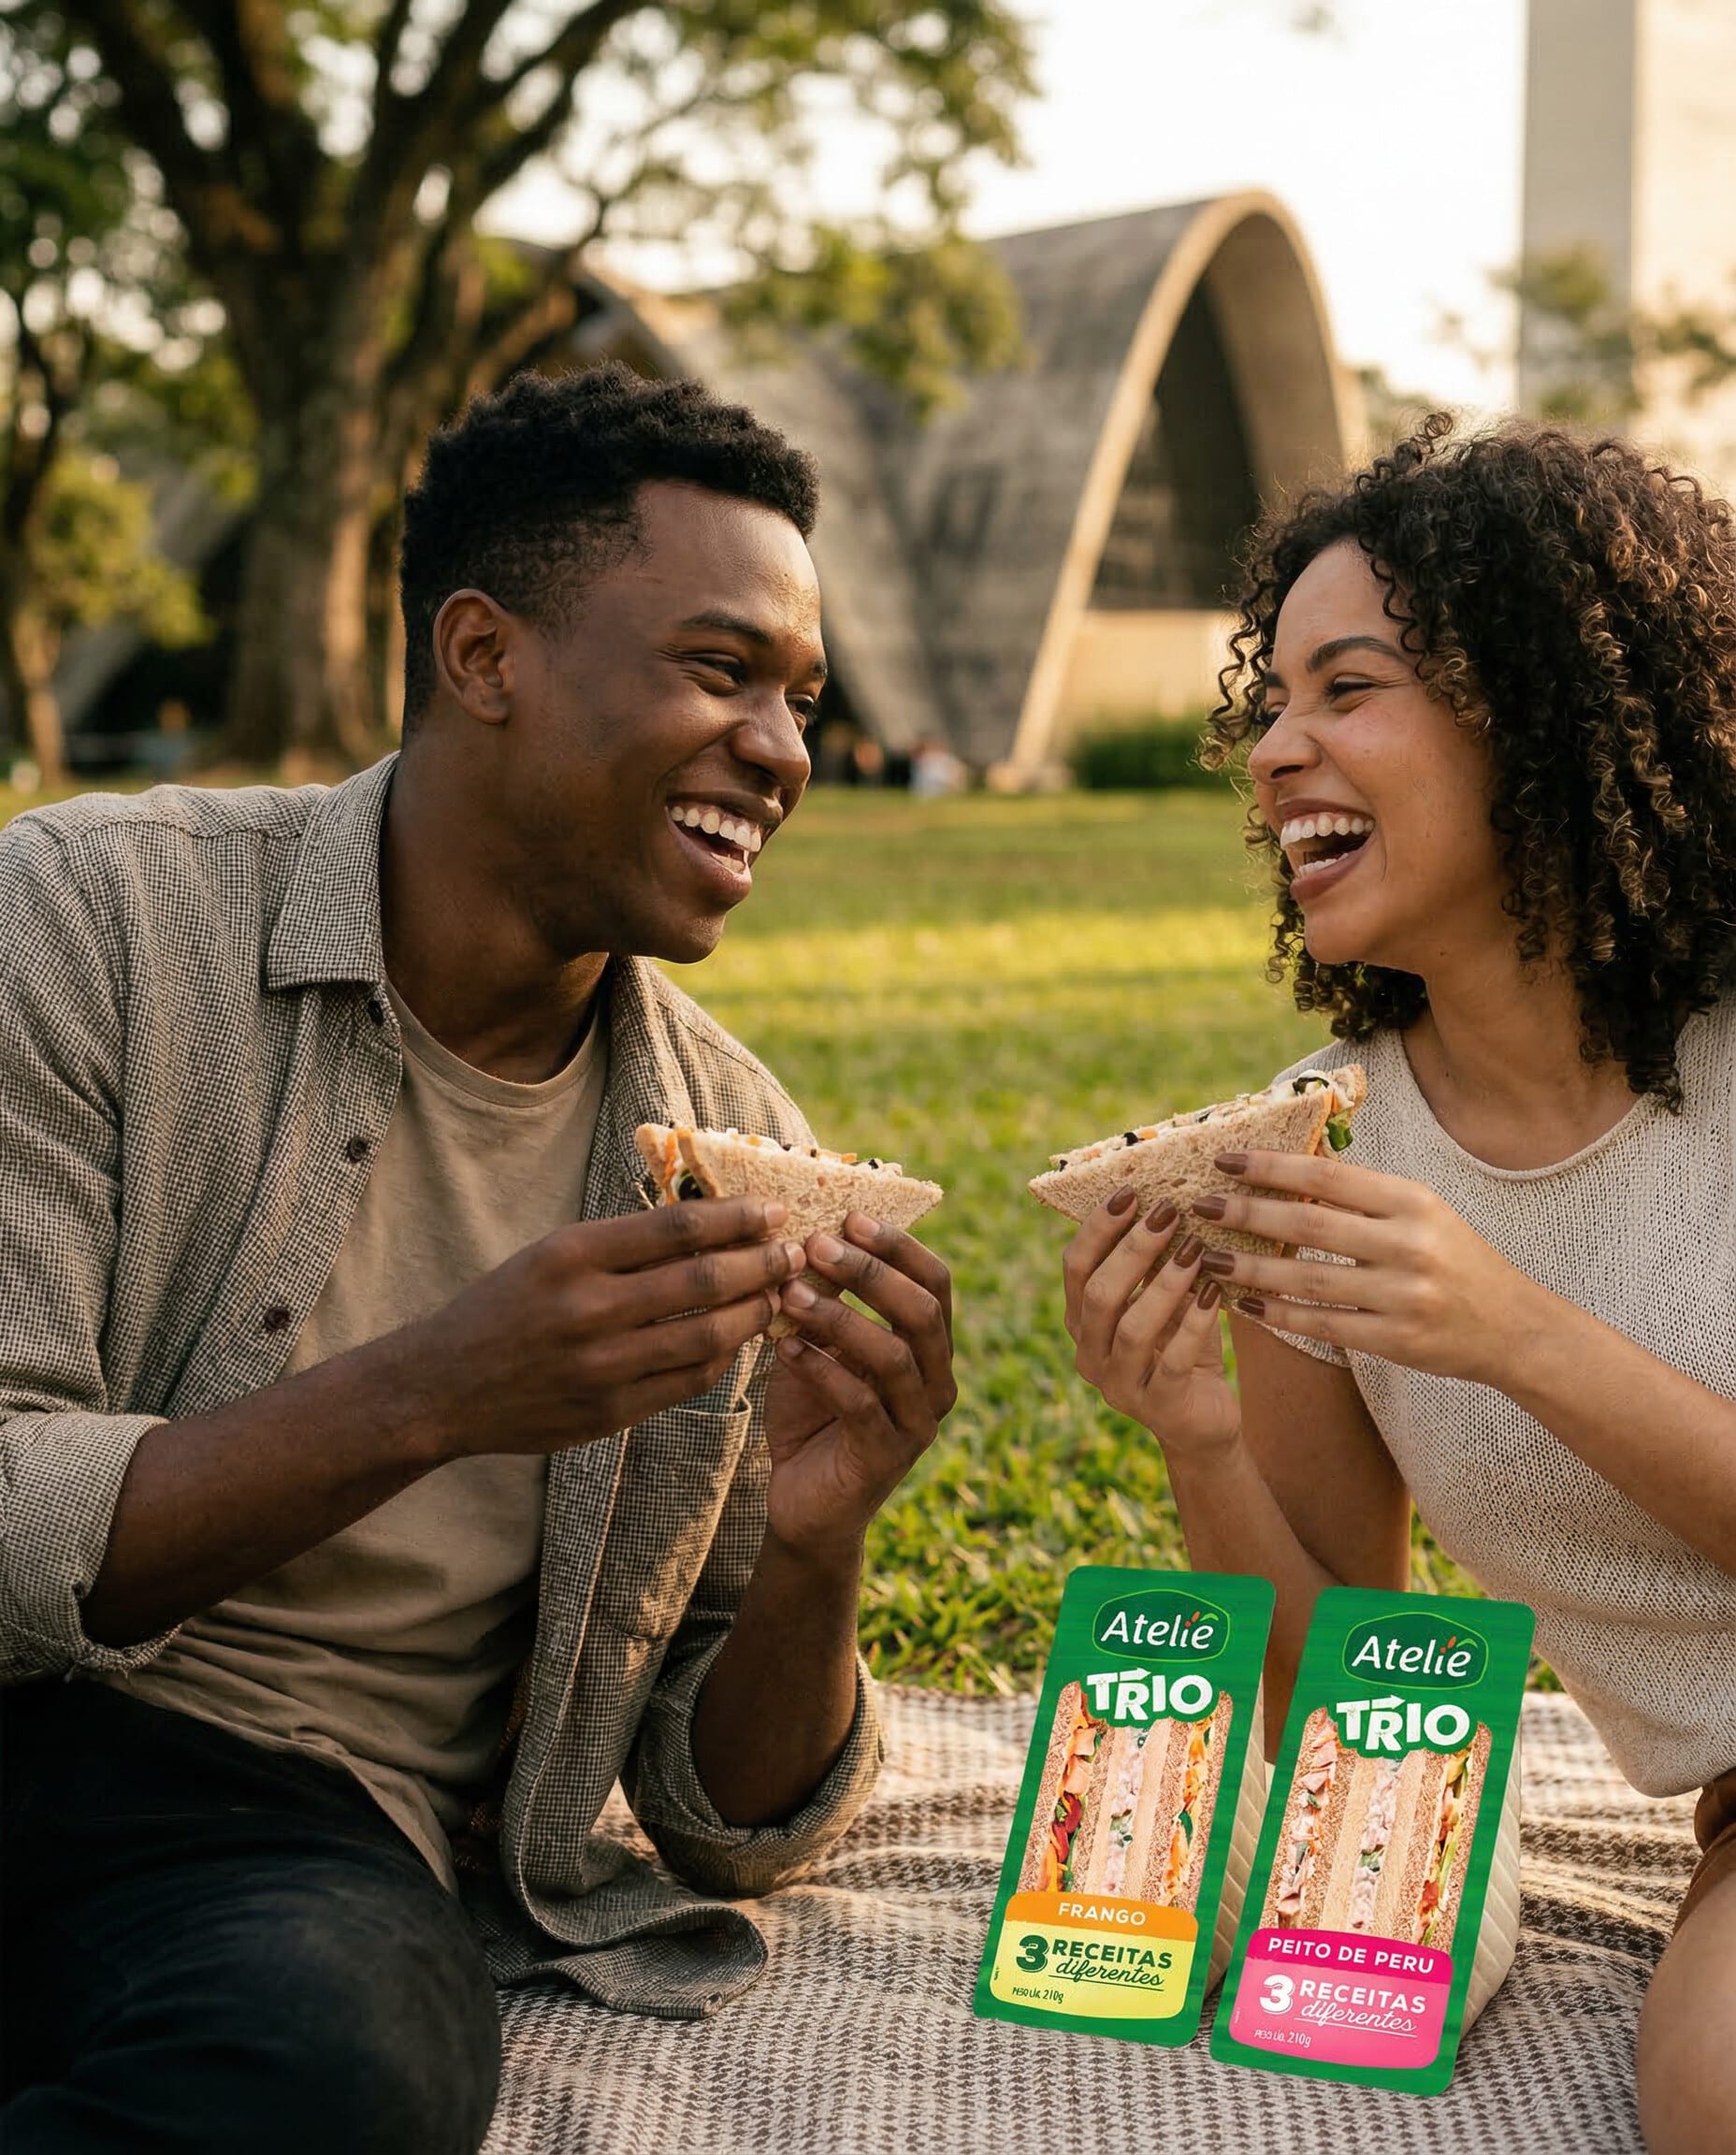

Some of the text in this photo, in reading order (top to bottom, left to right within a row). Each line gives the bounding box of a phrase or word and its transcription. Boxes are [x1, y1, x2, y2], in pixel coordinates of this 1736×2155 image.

[1087, 1667, 1213, 1721] TRIO
[1336, 1694, 1470, 1751] TRIO
[1058, 1902, 1147, 1926] FRANGO
[1016, 1934, 1049, 1974] 3
[1051, 1939, 1173, 1969] RECEITAS
[1267, 1937, 1434, 1974] PEITO DE PERU
[1055, 1958, 1165, 1987] diferentes
[1043, 1989, 1064, 2004] 210g
[1259, 1974, 1295, 2016] 3
[1299, 1979, 1426, 2015] RECEITAS
[1300, 1998, 1417, 2032] diferentes
[1287, 2032, 1311, 2048] 210g
